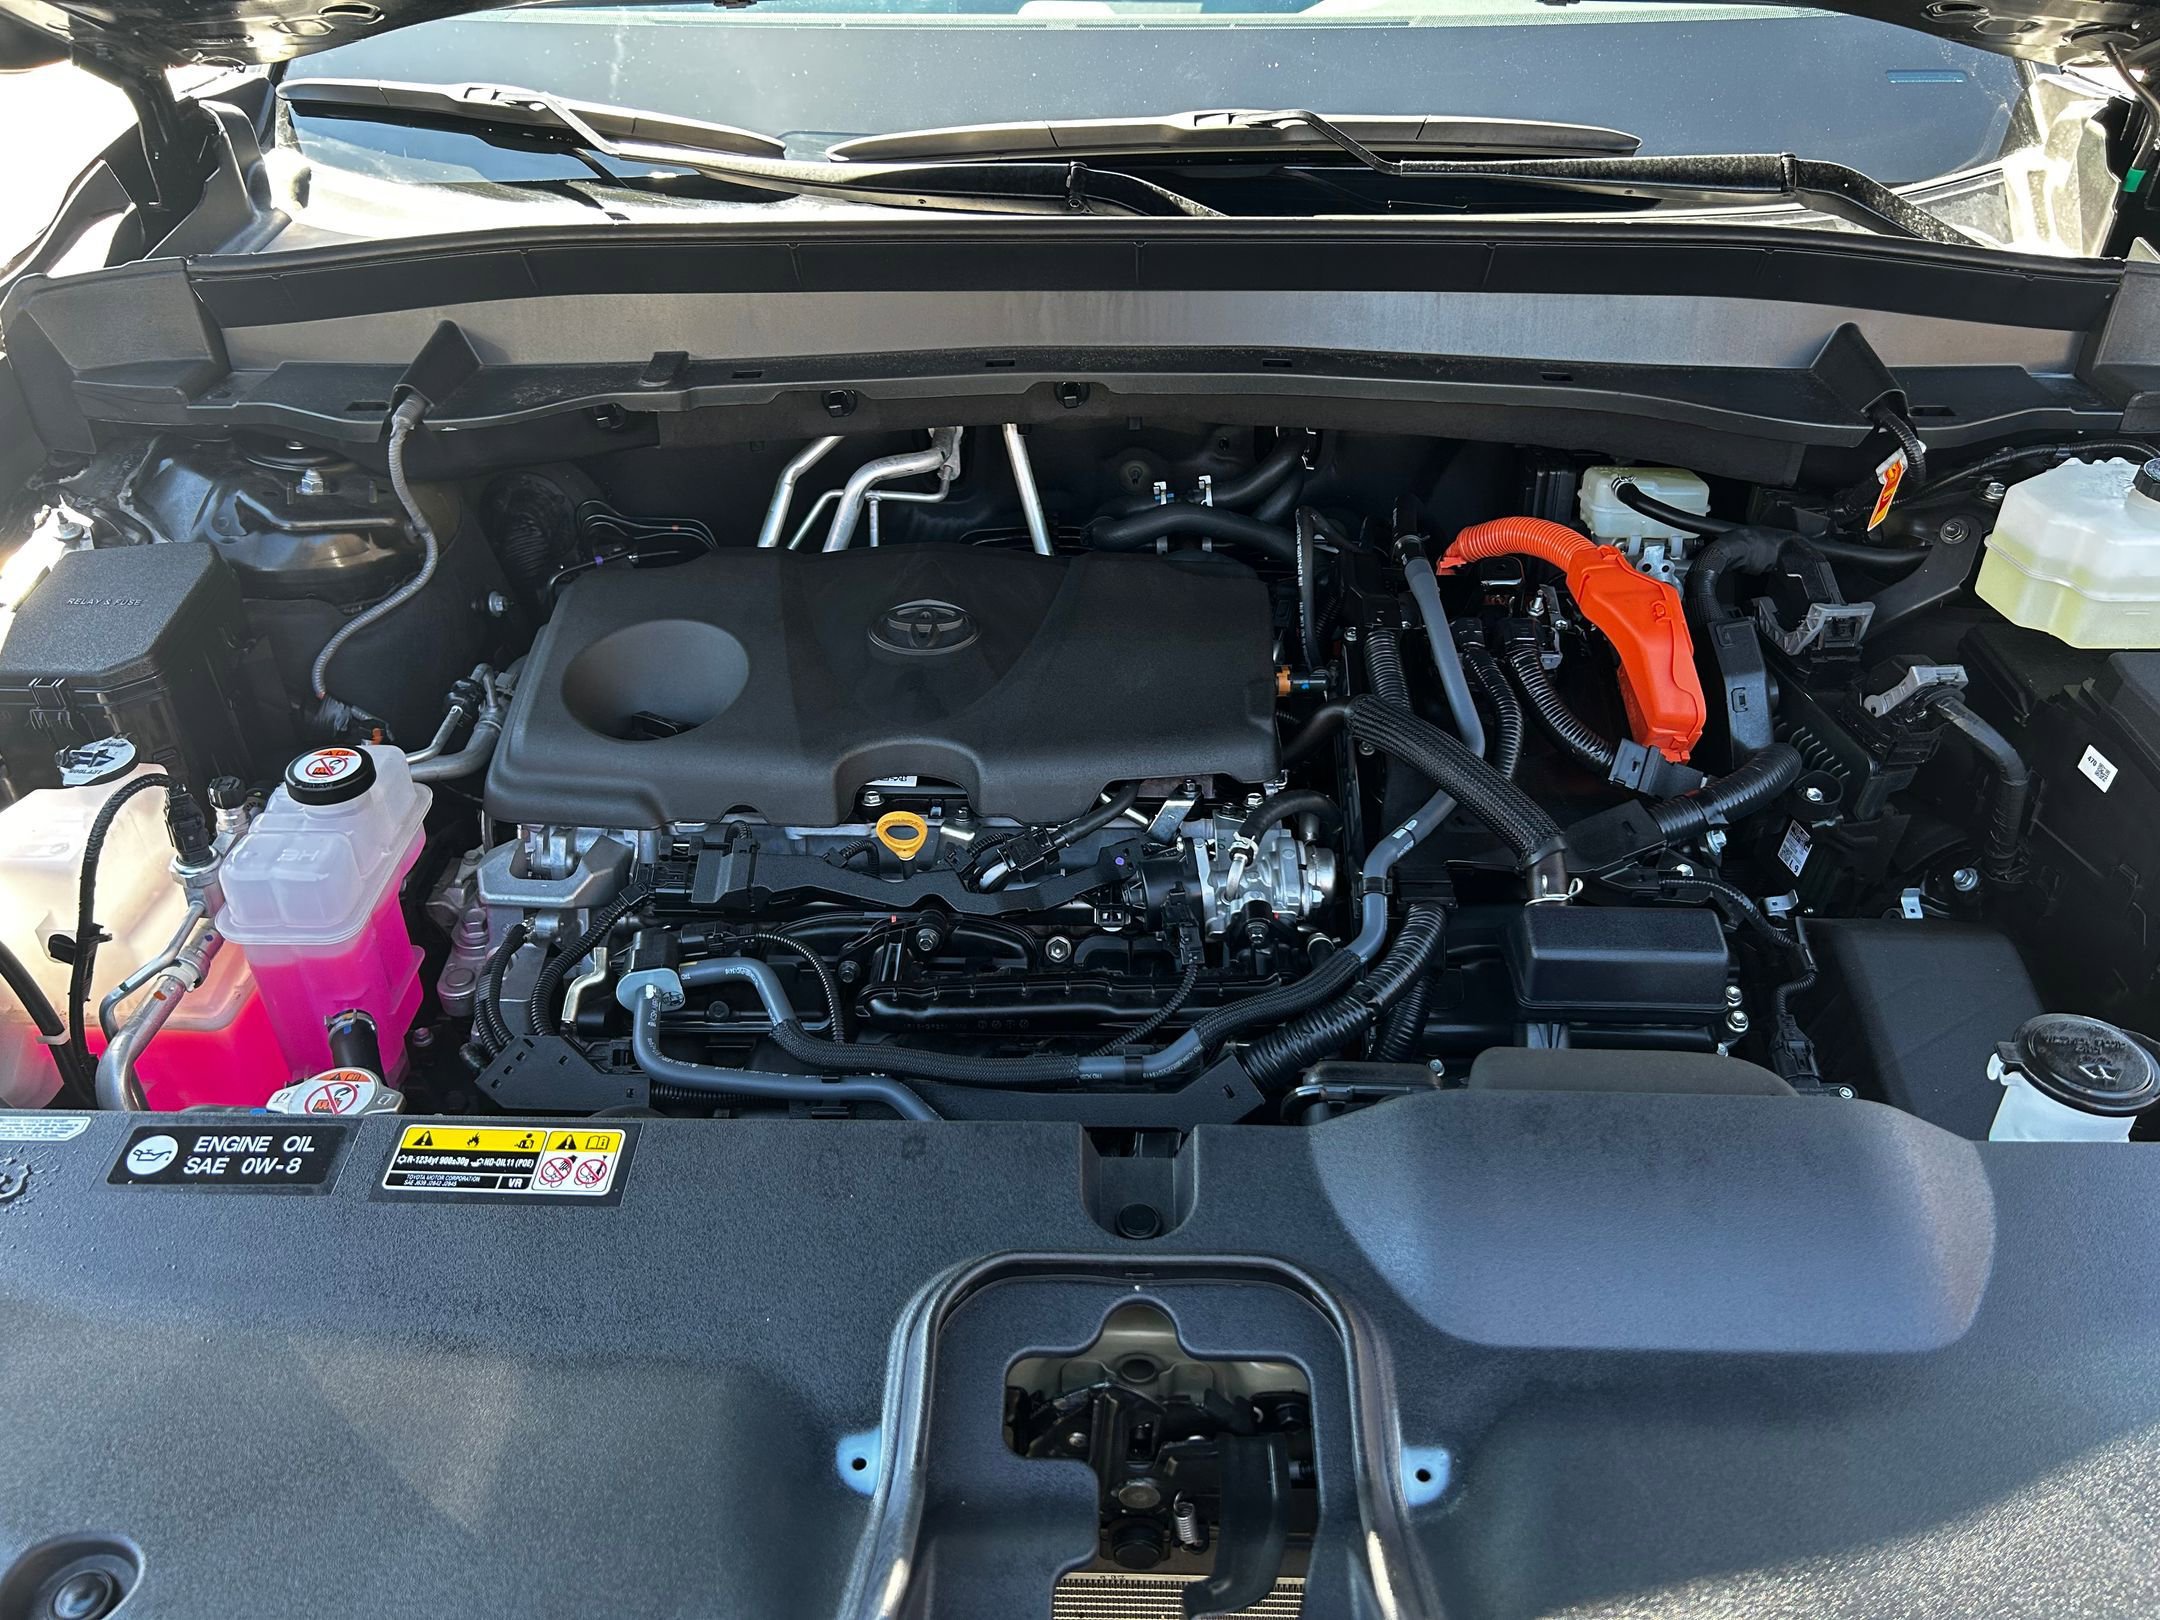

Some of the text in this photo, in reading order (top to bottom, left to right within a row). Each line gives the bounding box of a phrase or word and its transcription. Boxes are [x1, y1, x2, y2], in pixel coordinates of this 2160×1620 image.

[193, 1136, 315, 1152] ENGINE OIL
[183, 1157, 302, 1174] SAE 0W-8
[508, 1178, 523, 1188] VR
